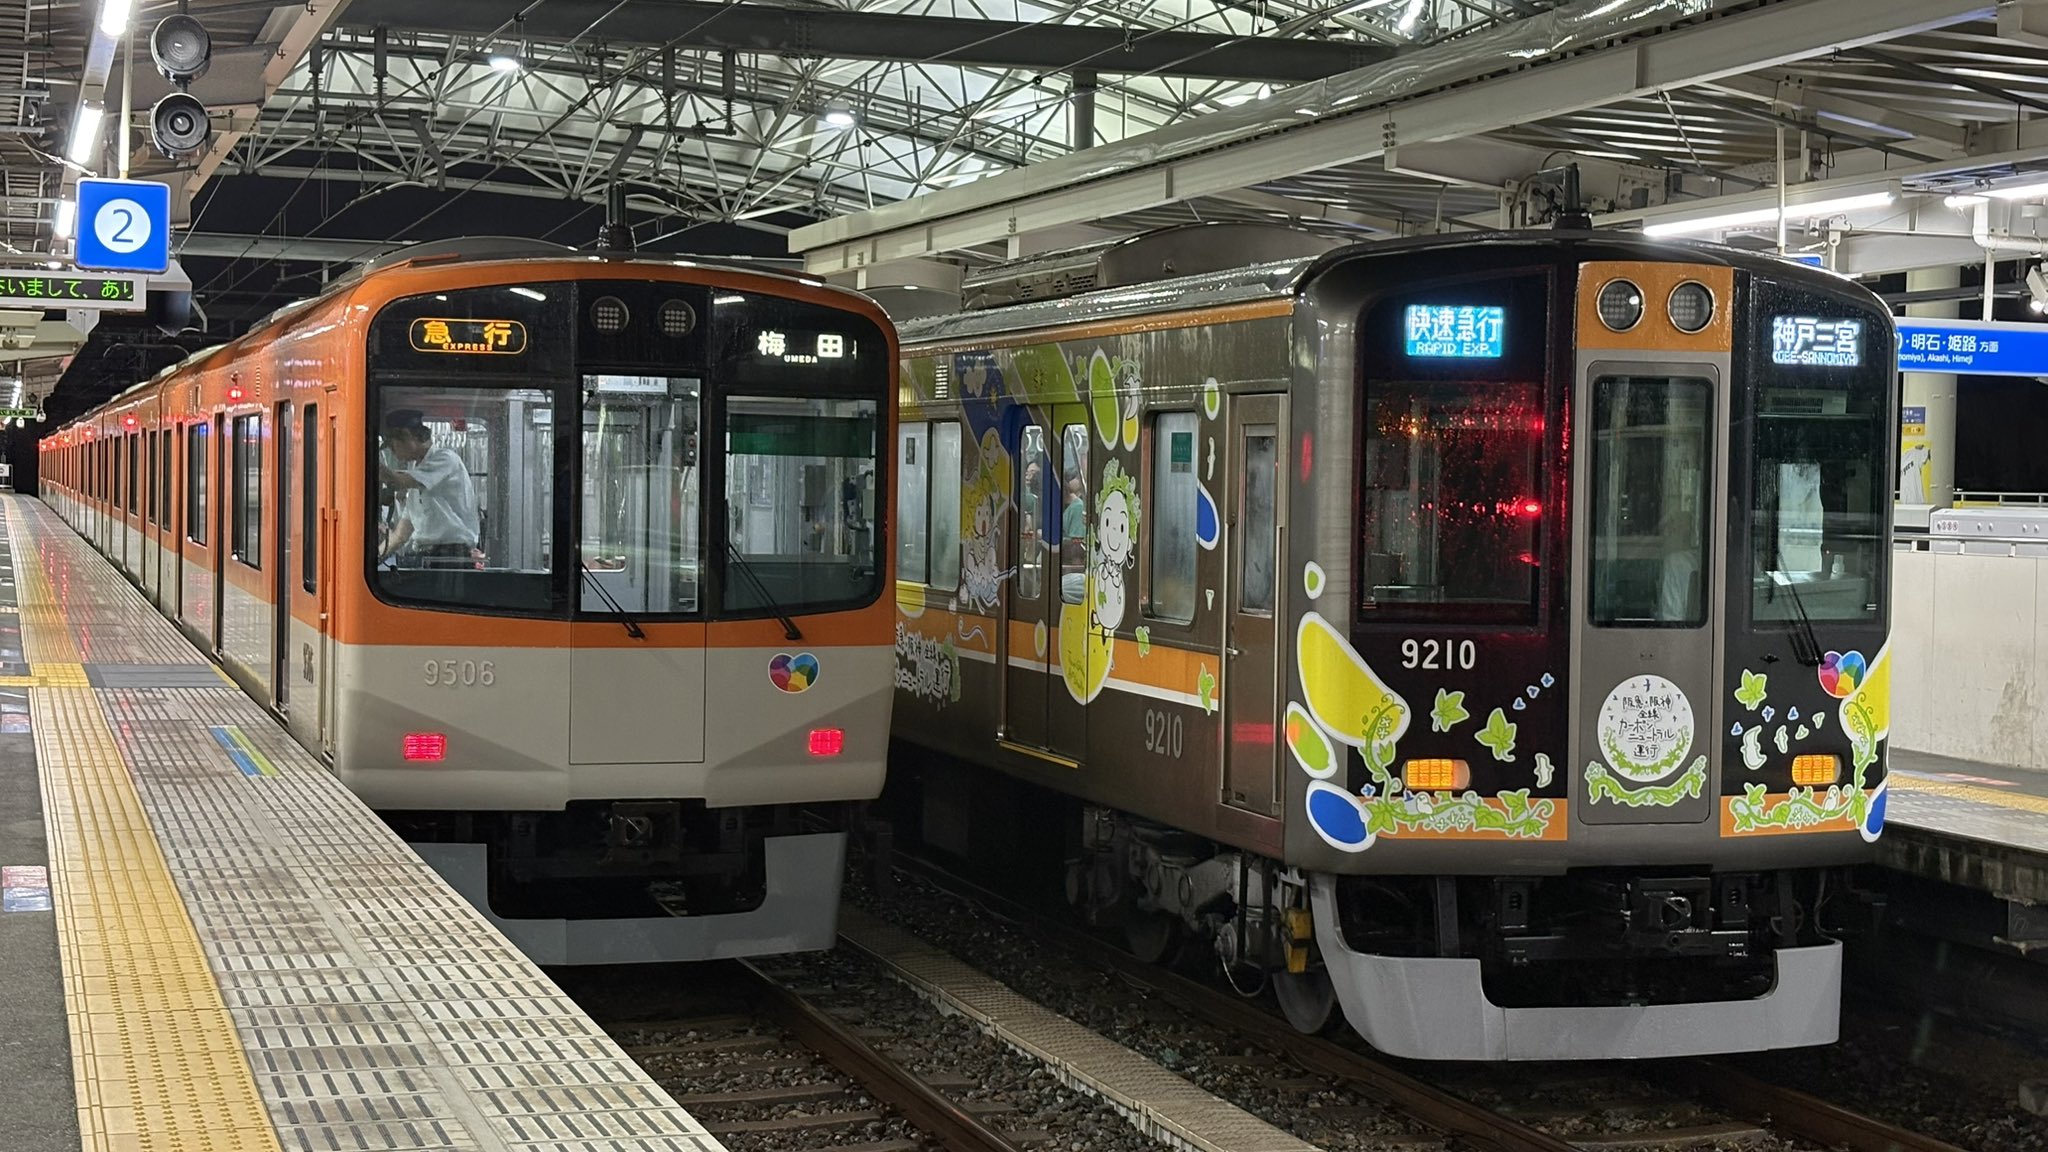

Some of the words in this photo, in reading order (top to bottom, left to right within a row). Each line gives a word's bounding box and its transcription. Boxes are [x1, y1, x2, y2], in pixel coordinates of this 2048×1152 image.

[111, 208, 134, 243] 2
[1407, 305, 1503, 342] 快速急行
[1773, 317, 1860, 353] 神戸三宮
[442, 343, 493, 351] EXPRESS
[1415, 342, 1457, 354] RAPID
[783, 354, 818, 363] UMEDA
[1952, 354, 1973, 365] Himeji
[1401, 638, 1476, 670] 9210
[424, 659, 495, 686] 9506
[1638, 708, 1660, 720] 全線
[1145, 708, 1183, 759] 9210
[1618, 719, 1653, 735] カーボン
[1628, 727, 1675, 741] ニュートラル
[1633, 744, 1659, 758] 運行
